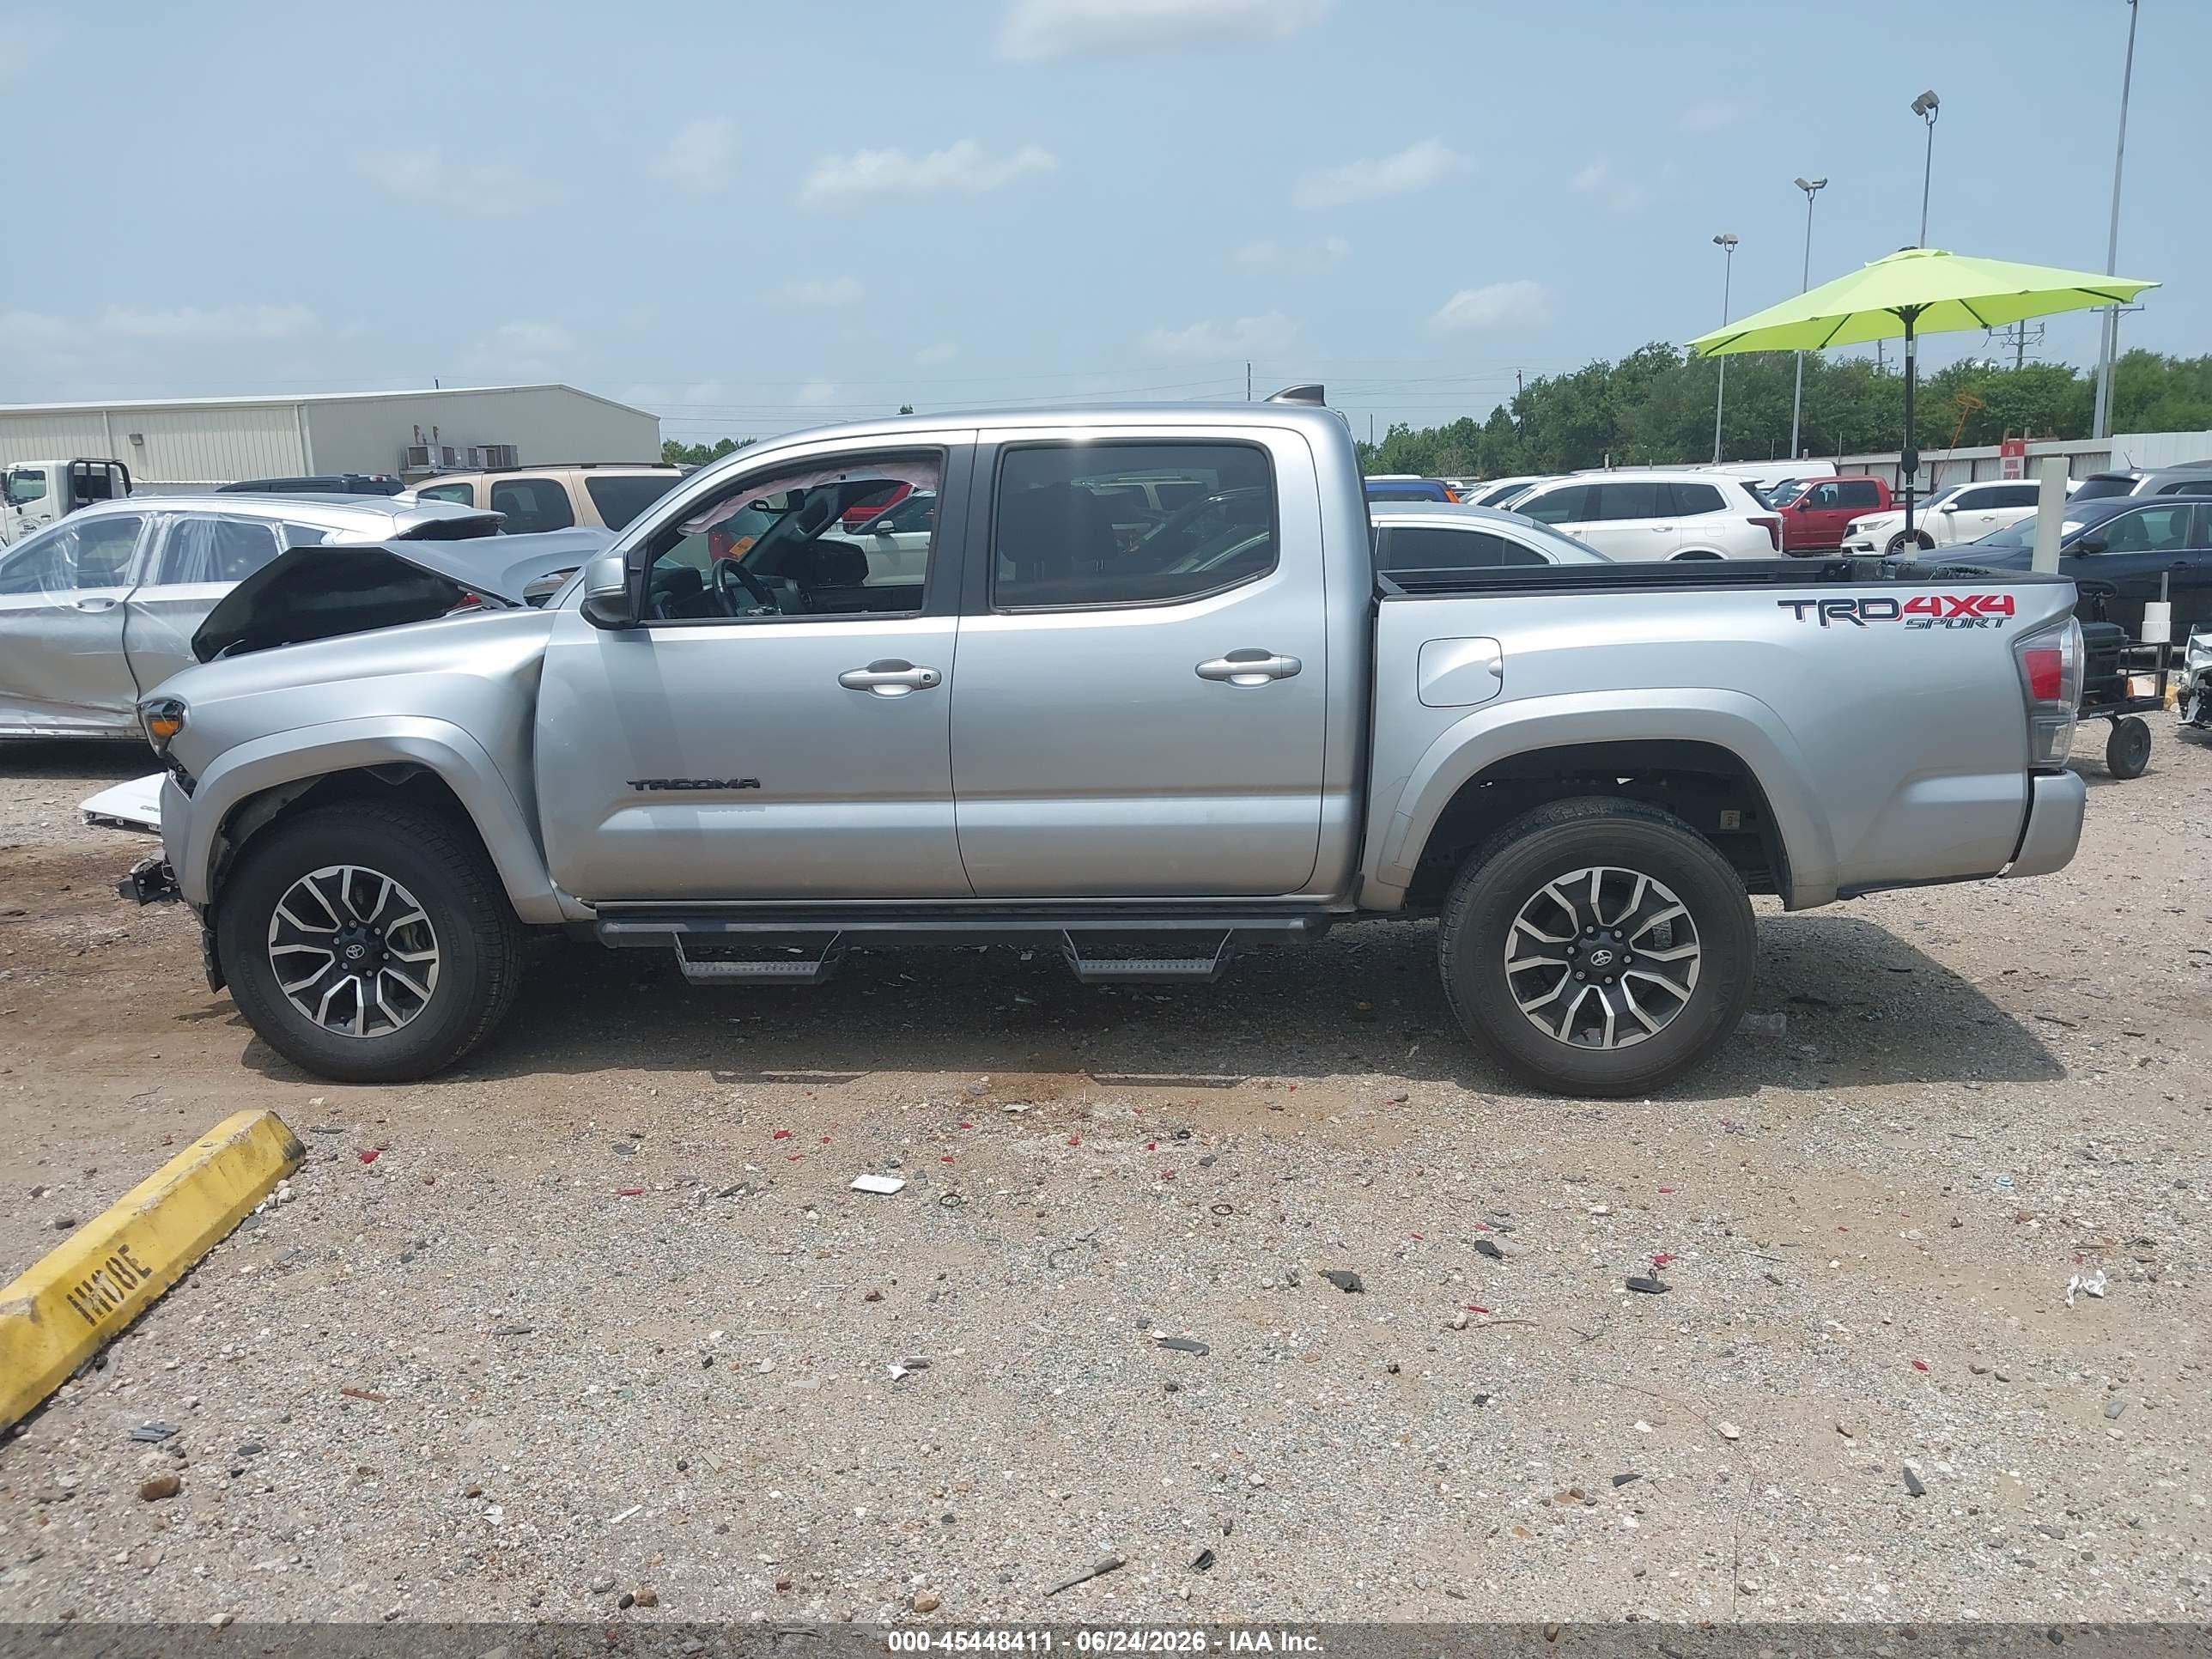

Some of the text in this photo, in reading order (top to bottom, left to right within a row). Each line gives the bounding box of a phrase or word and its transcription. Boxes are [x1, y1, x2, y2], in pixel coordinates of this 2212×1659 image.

[1777, 598, 1904, 629] TRD
[1904, 617, 2013, 630] SPORT
[626, 777, 761, 790] TACOMA
